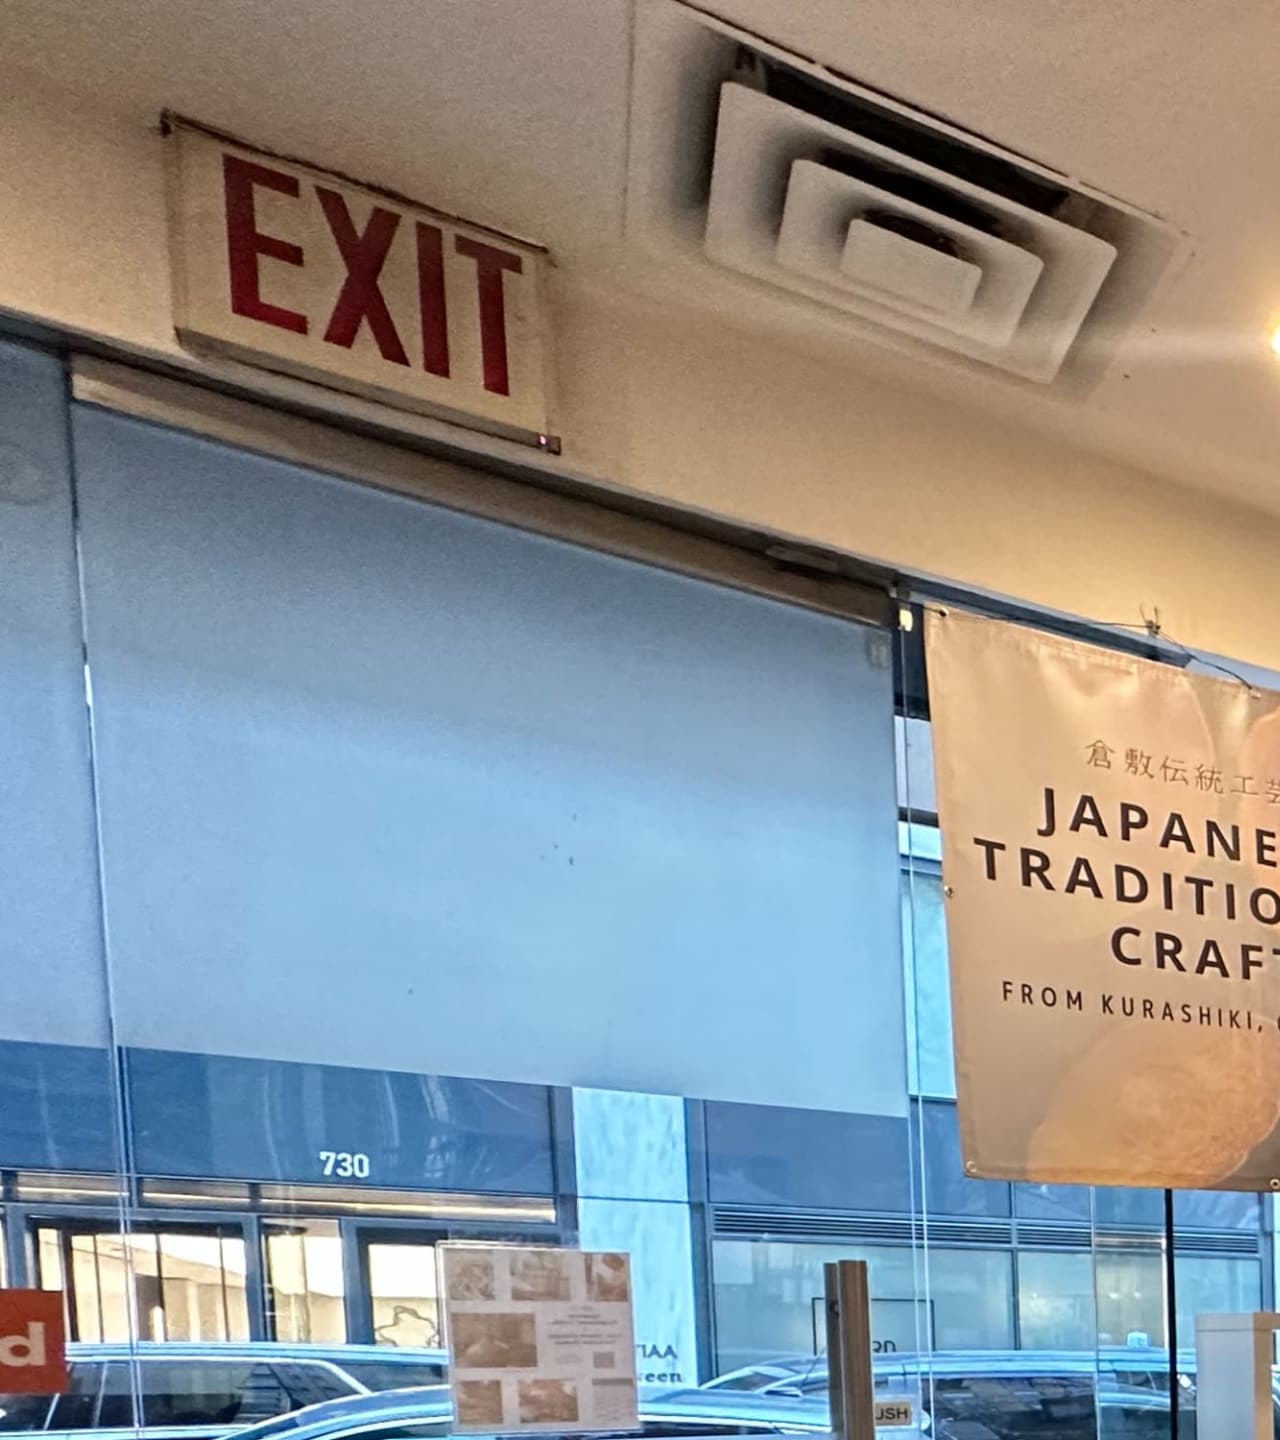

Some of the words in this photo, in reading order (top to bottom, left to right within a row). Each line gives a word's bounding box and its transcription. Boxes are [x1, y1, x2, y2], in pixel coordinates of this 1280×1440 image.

[222, 153, 522, 397] EXIT
[1002, 980, 1083, 1011] FROM
[1101, 994, 1264, 1032] KURASHIKI,
[319, 1151, 370, 1178] 730
